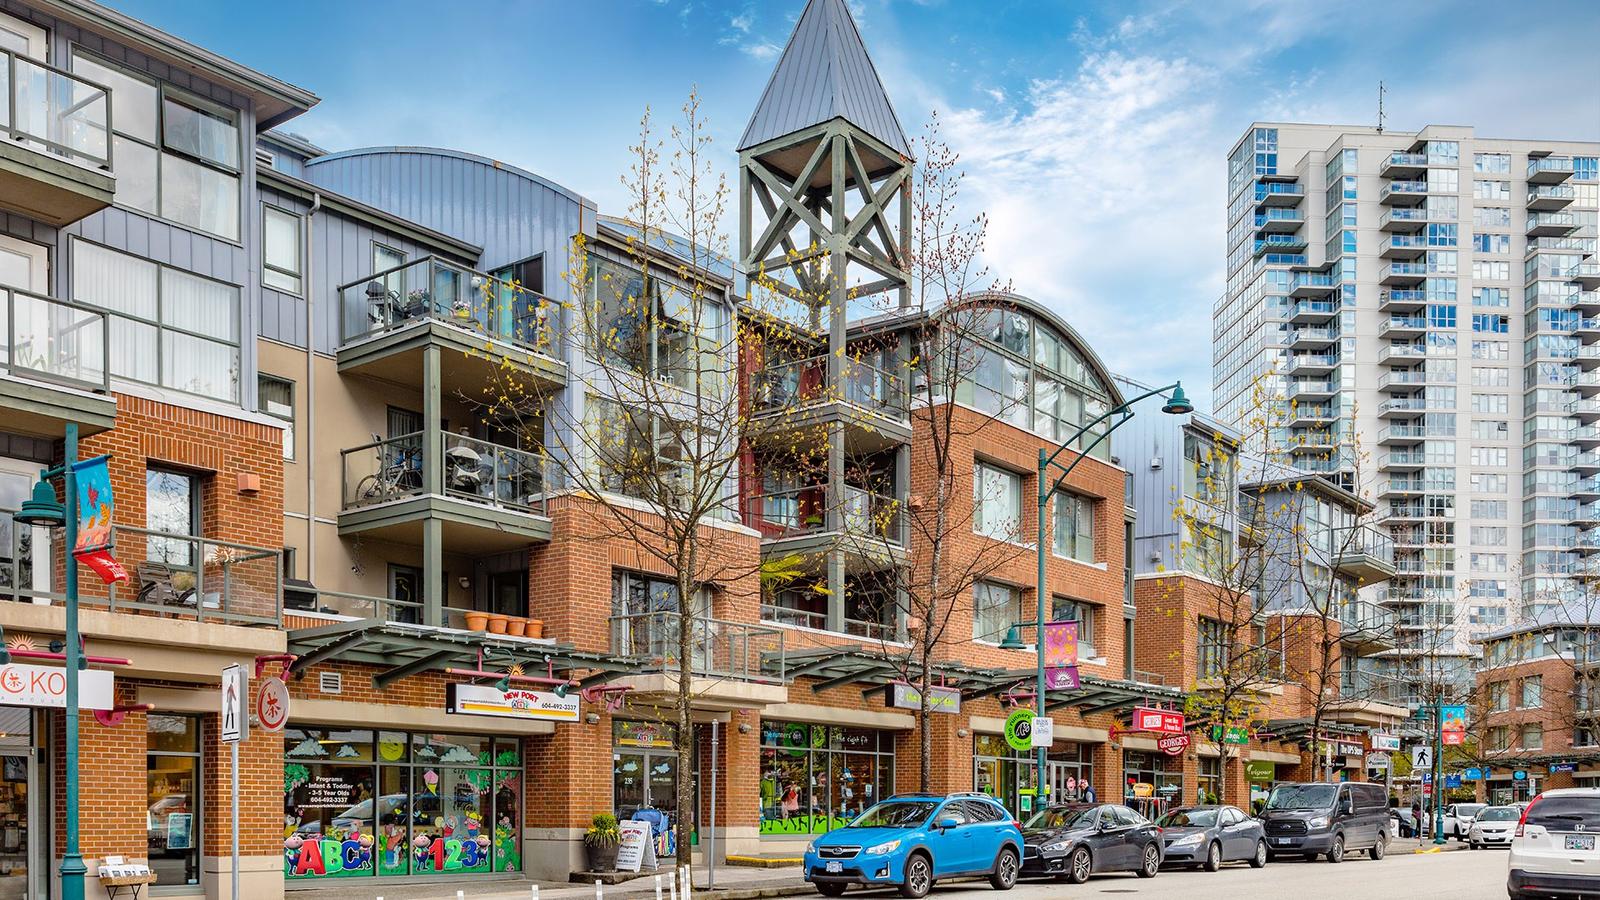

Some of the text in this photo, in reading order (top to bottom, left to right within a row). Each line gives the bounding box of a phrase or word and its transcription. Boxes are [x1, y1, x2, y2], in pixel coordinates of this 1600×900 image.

[503, 691, 539, 703] NEW PORT
[541, 702, 577, 710] 604-492-3337
[1160, 736, 1189, 749] GEORGE'S
[296, 839, 361, 875] ABC
[429, 838, 478, 870] 123
